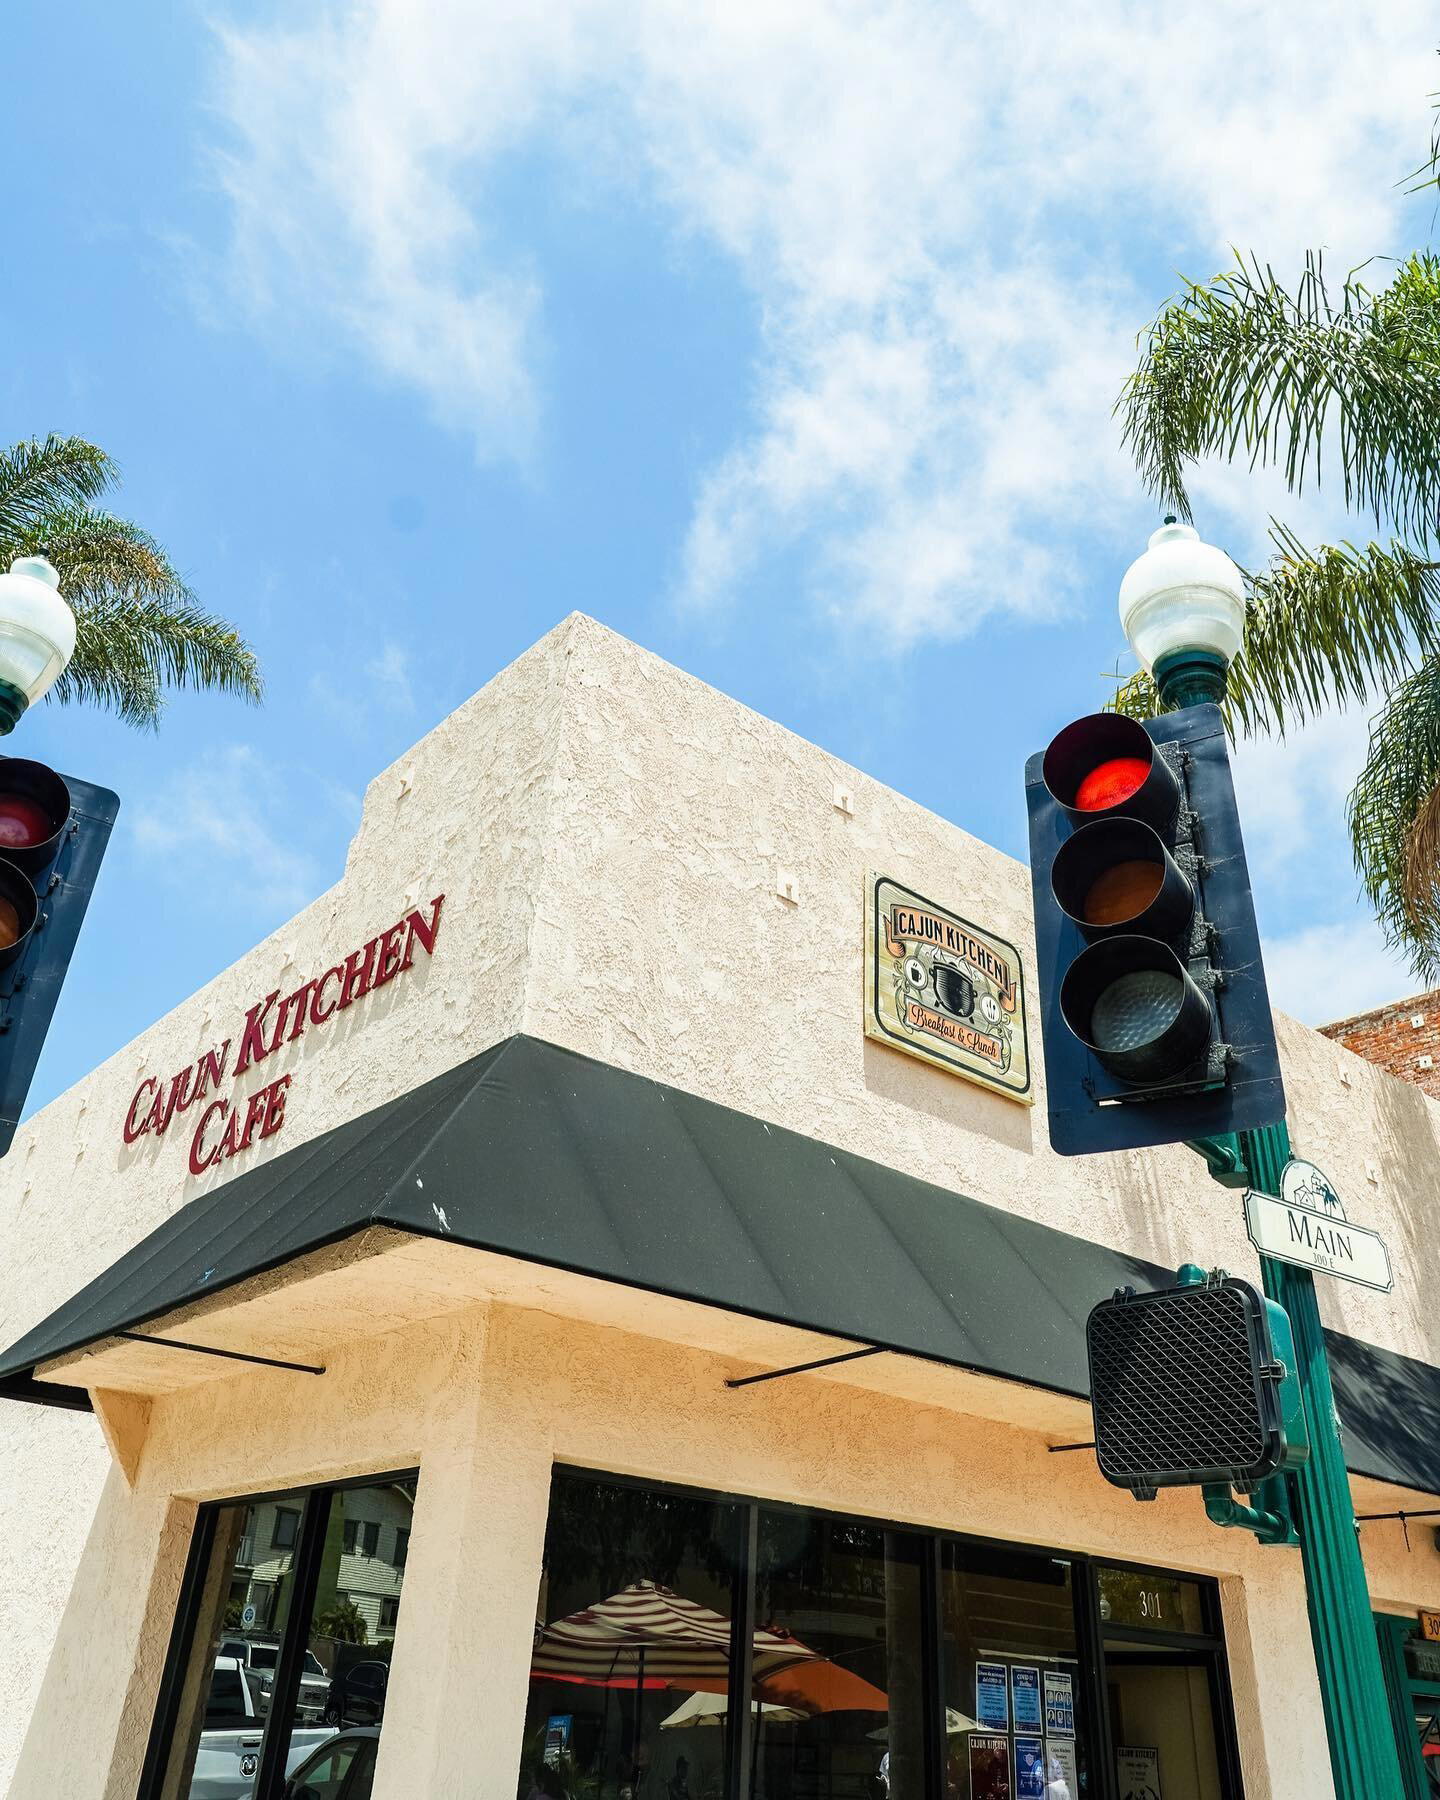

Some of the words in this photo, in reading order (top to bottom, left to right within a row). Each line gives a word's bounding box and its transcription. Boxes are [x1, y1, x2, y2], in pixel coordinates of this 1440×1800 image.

[899, 911, 943, 941] CAJUN
[946, 928, 1003, 985] KITCHEN
[123, 1038, 231, 1144] CAJUN
[232, 893, 446, 1077] KITCHEN
[911, 1004, 956, 1038] Breakfast
[958, 1029, 965, 1042] &
[967, 1032, 997, 1058] Lunch
[188, 1074, 292, 1175] CAFE
[1287, 1209, 1353, 1262] MAIN
[1313, 1252, 1328, 1267] 300
[1330, 1257, 1335, 1268] E
[1139, 1590, 1162, 1619] 301
[1428, 1616, 1440, 1636] 30
[970, 1738, 986, 1749] CAJUN
[987, 1739, 1006, 1750] KITCHEN
